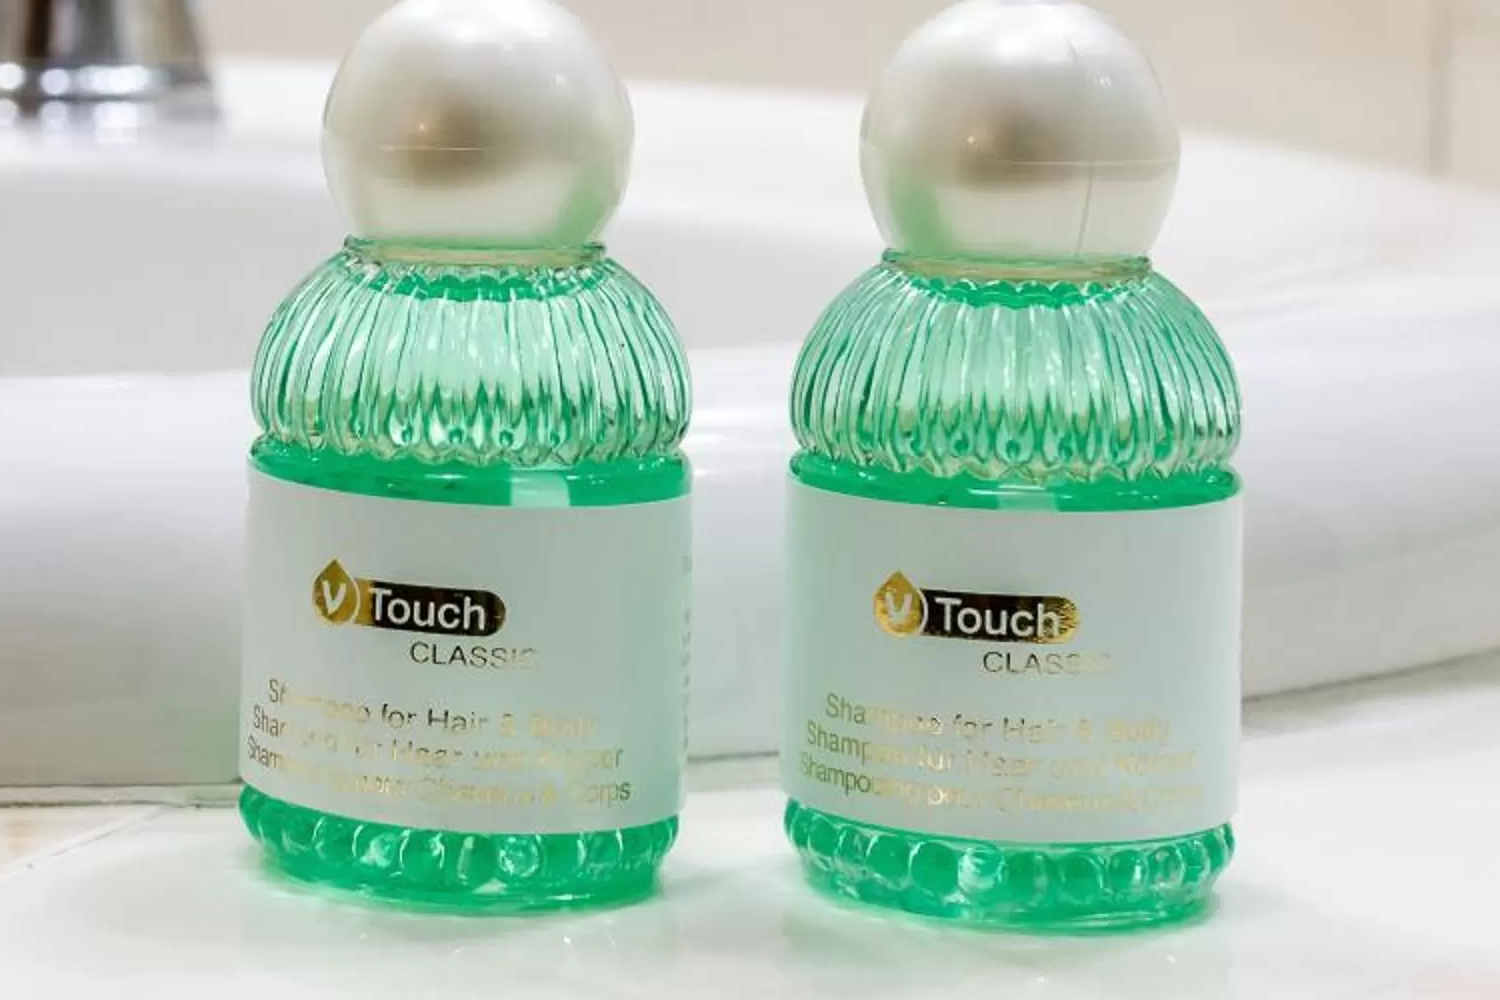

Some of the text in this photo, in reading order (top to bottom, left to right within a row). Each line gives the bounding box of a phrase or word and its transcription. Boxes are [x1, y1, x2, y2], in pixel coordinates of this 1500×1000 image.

[369, 587, 485, 631] Touch
[935, 597, 1061, 638] Touch
[427, 707, 489, 733] Hair
